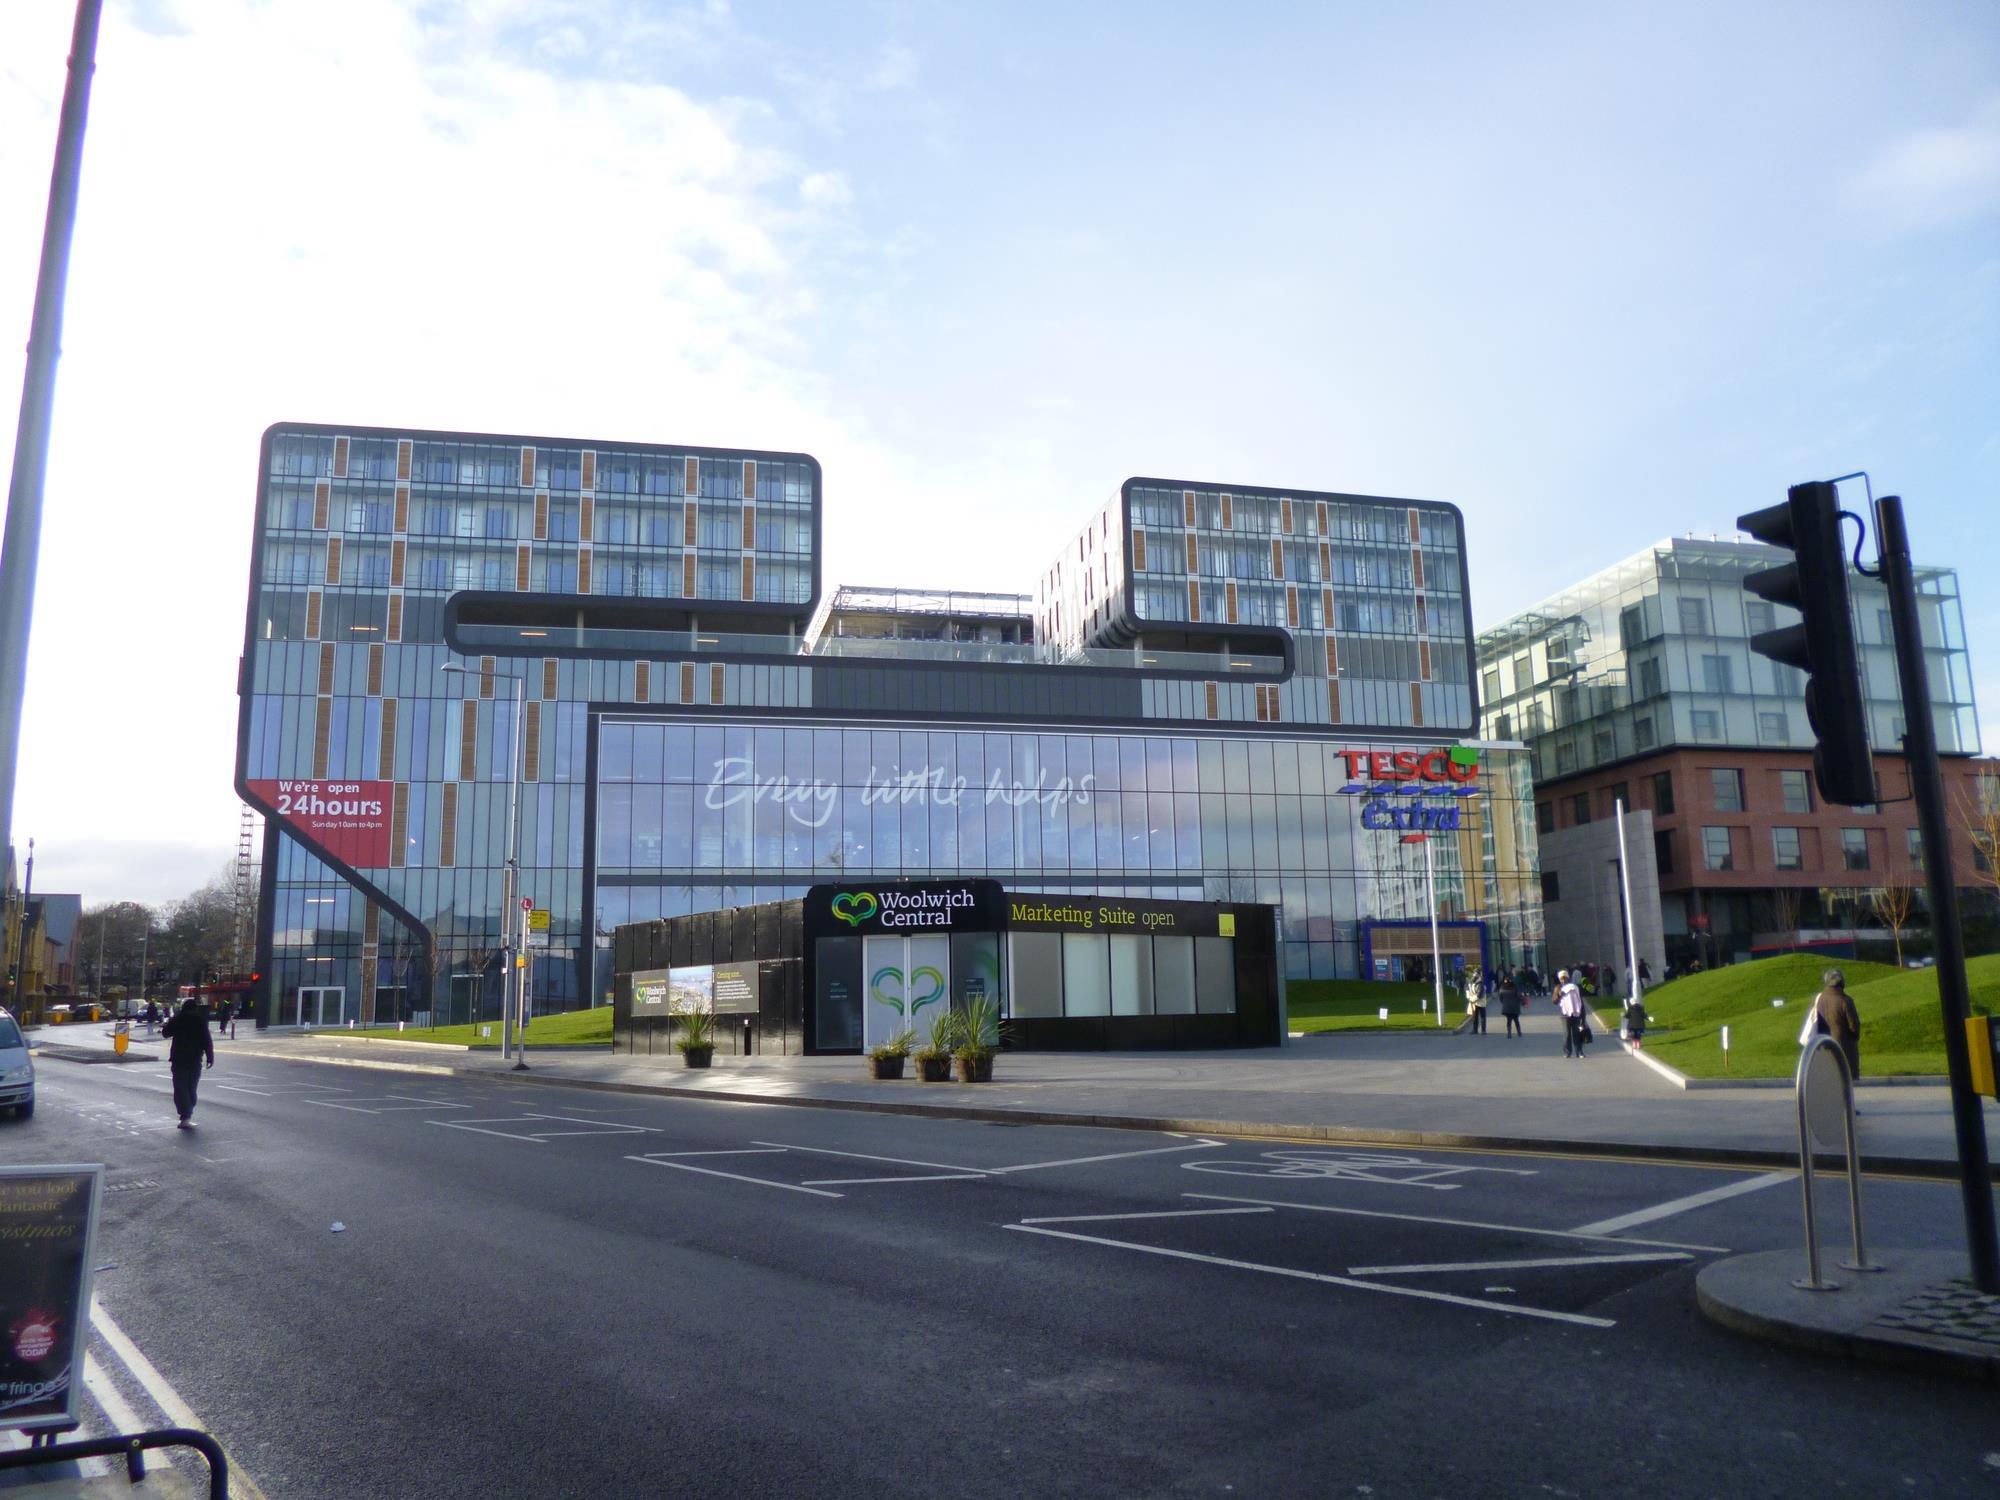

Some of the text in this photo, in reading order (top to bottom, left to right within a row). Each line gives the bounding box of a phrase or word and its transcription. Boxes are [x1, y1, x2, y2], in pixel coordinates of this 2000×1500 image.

[1337, 750, 1479, 782] TESCO
[279, 781, 360, 795] We're open
[704, 756, 1097, 828] Every little helps
[277, 794, 382, 816] 24hours
[312, 821, 338, 829] Sunday
[878, 889, 975, 909] Woolwich
[881, 907, 953, 927] Central
[1011, 903, 1175, 930] Marketing Suite open
